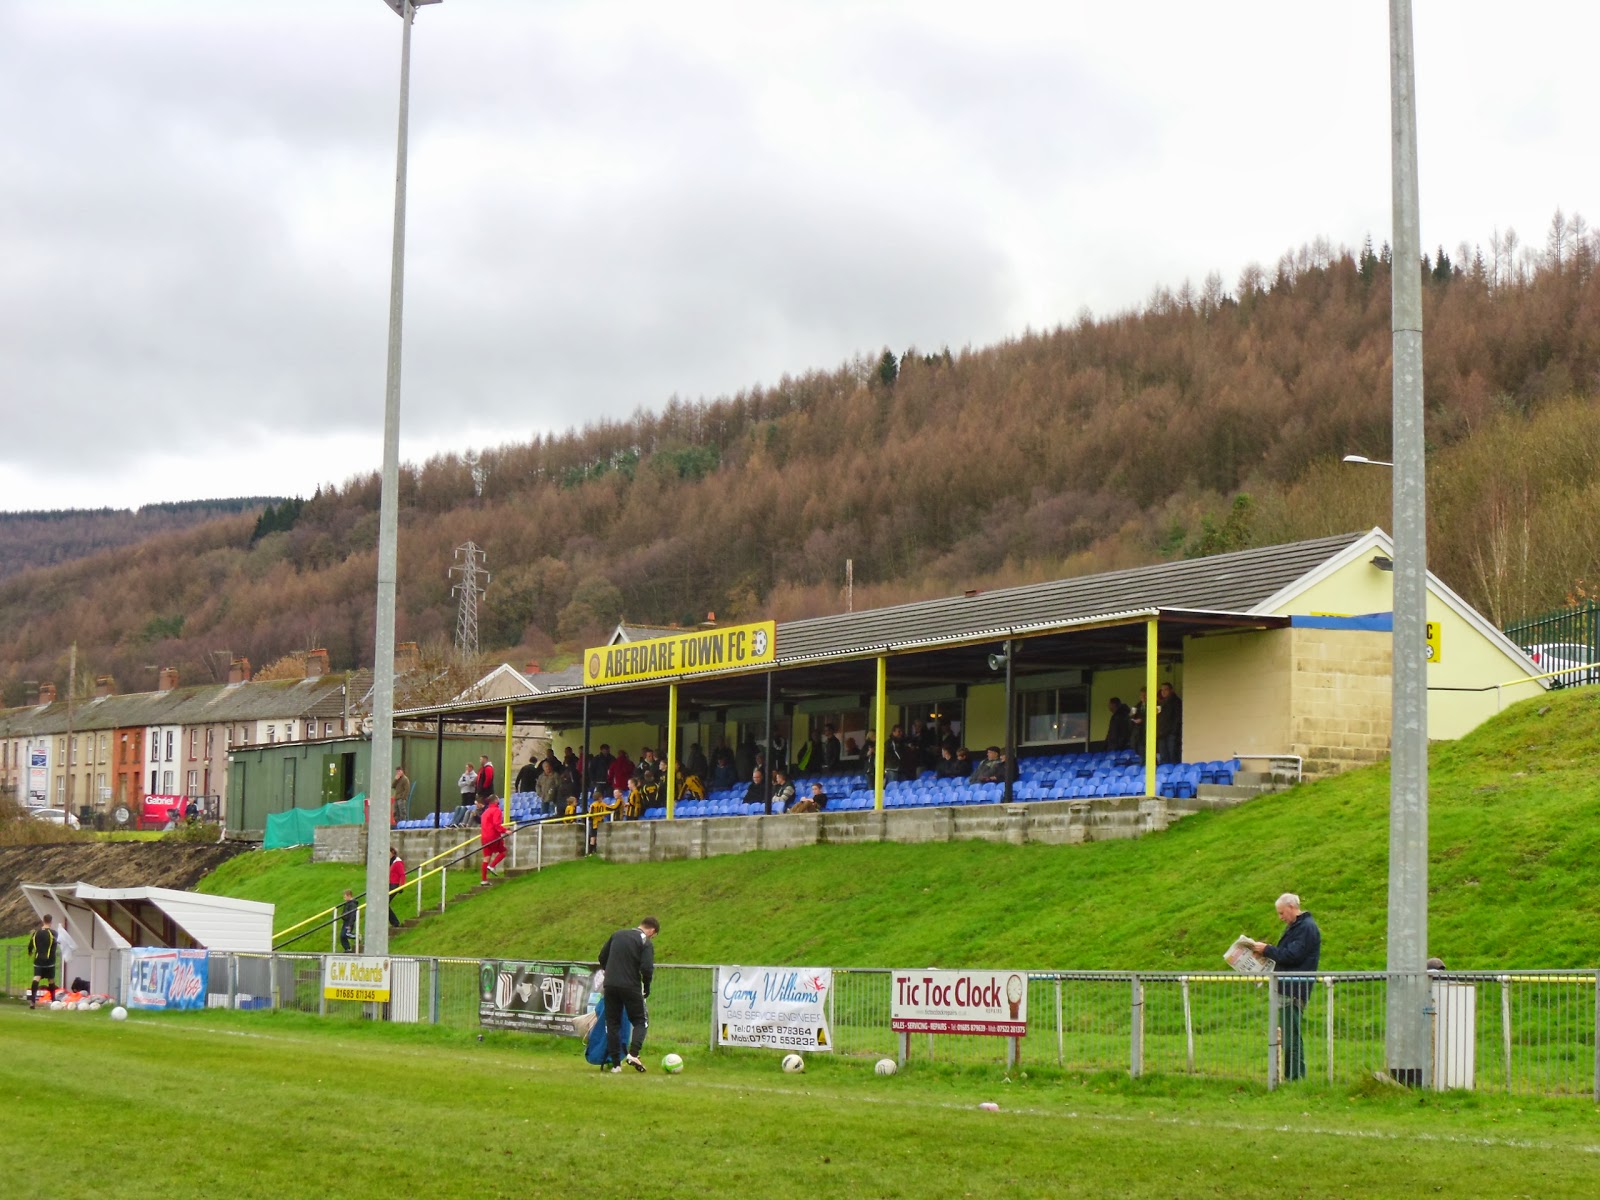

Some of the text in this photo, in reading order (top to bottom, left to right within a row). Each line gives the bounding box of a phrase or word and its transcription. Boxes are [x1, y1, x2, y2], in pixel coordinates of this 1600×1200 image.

[604, 630, 746, 678] ABERDARE TOWN FC
[145, 796, 174, 805] Gabriel
[350, 962, 383, 982] Richards
[336, 989, 354, 999] 01685
[723, 971, 818, 1009] Gary Williams
[897, 976, 1002, 1008] Tic Toc Clock
[727, 1010, 743, 1020] GAS
[745, 1011, 776, 1021] SERVICE
[907, 1022, 928, 1030] SERVICING
[930, 1022, 947, 1030] REPAIRS
